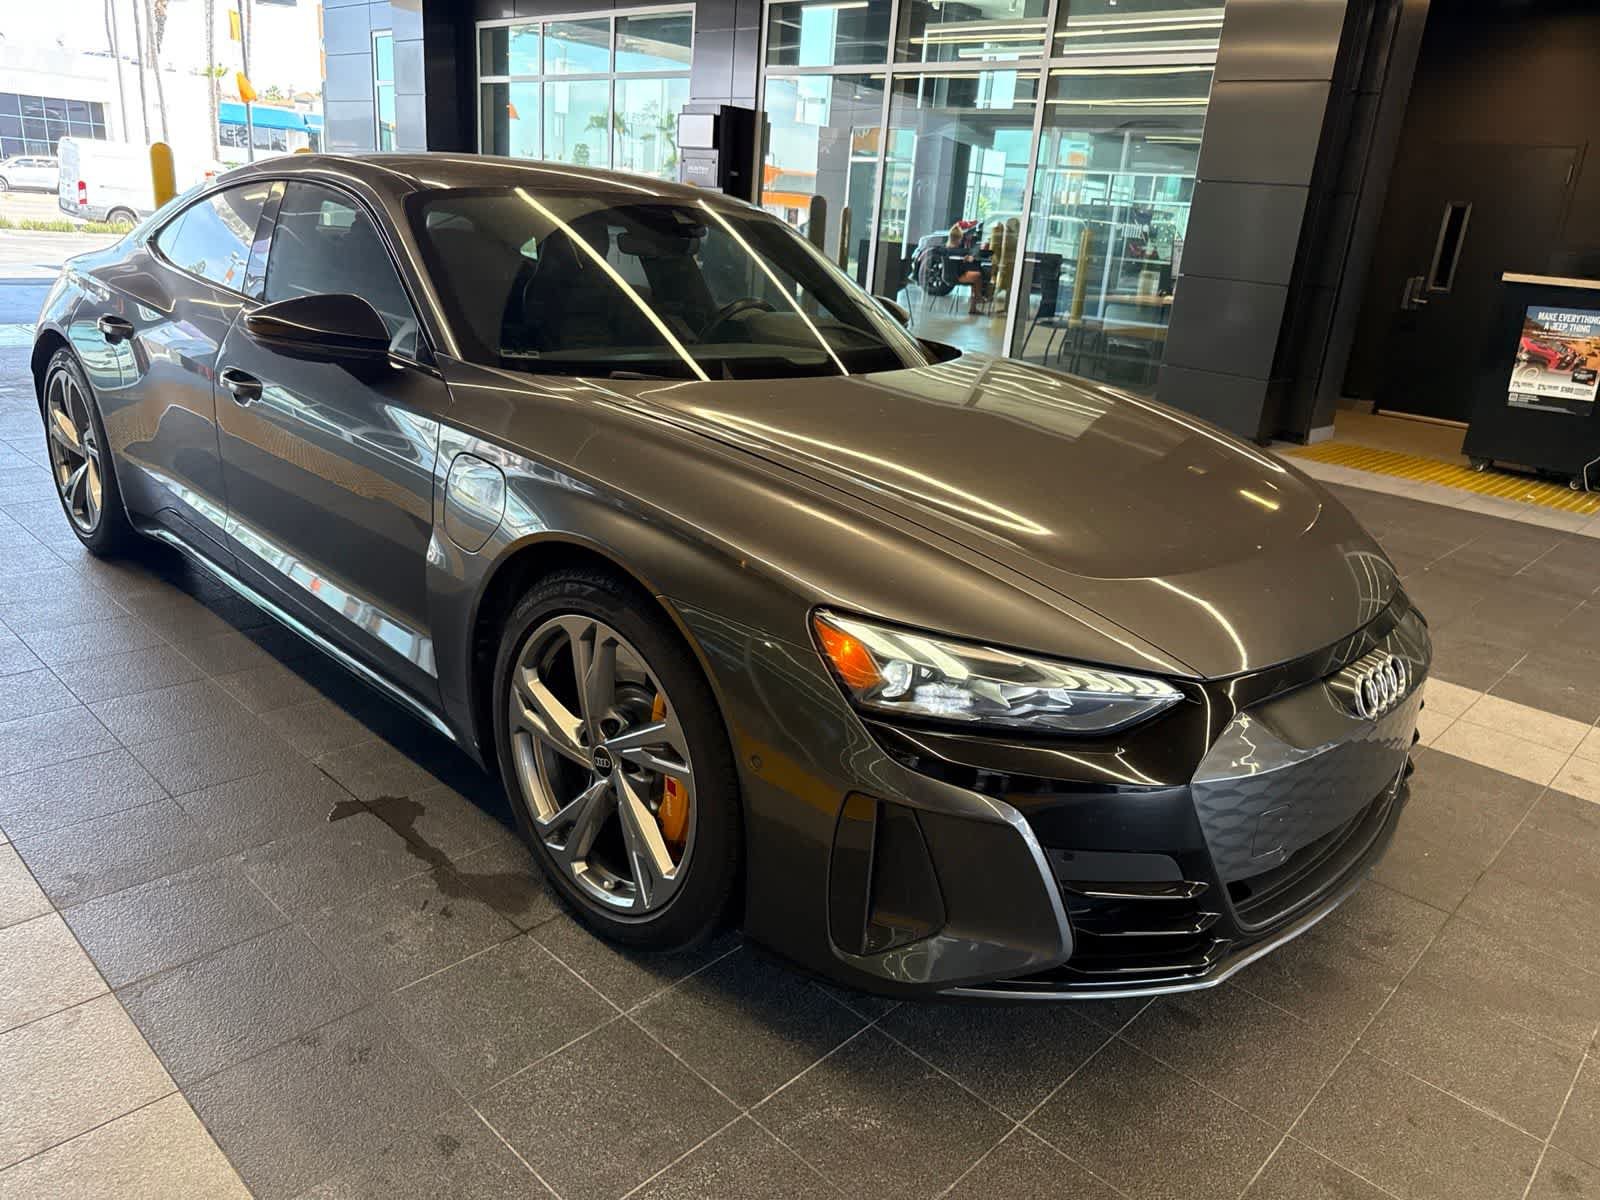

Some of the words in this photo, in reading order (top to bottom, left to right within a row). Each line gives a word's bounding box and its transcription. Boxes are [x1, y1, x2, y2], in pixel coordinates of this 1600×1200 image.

[1538, 312, 1558, 322] MAKE
[1544, 322, 1550, 330] A
[1550, 322, 1568, 331] JEEP
[1569, 323, 1591, 333] THING
